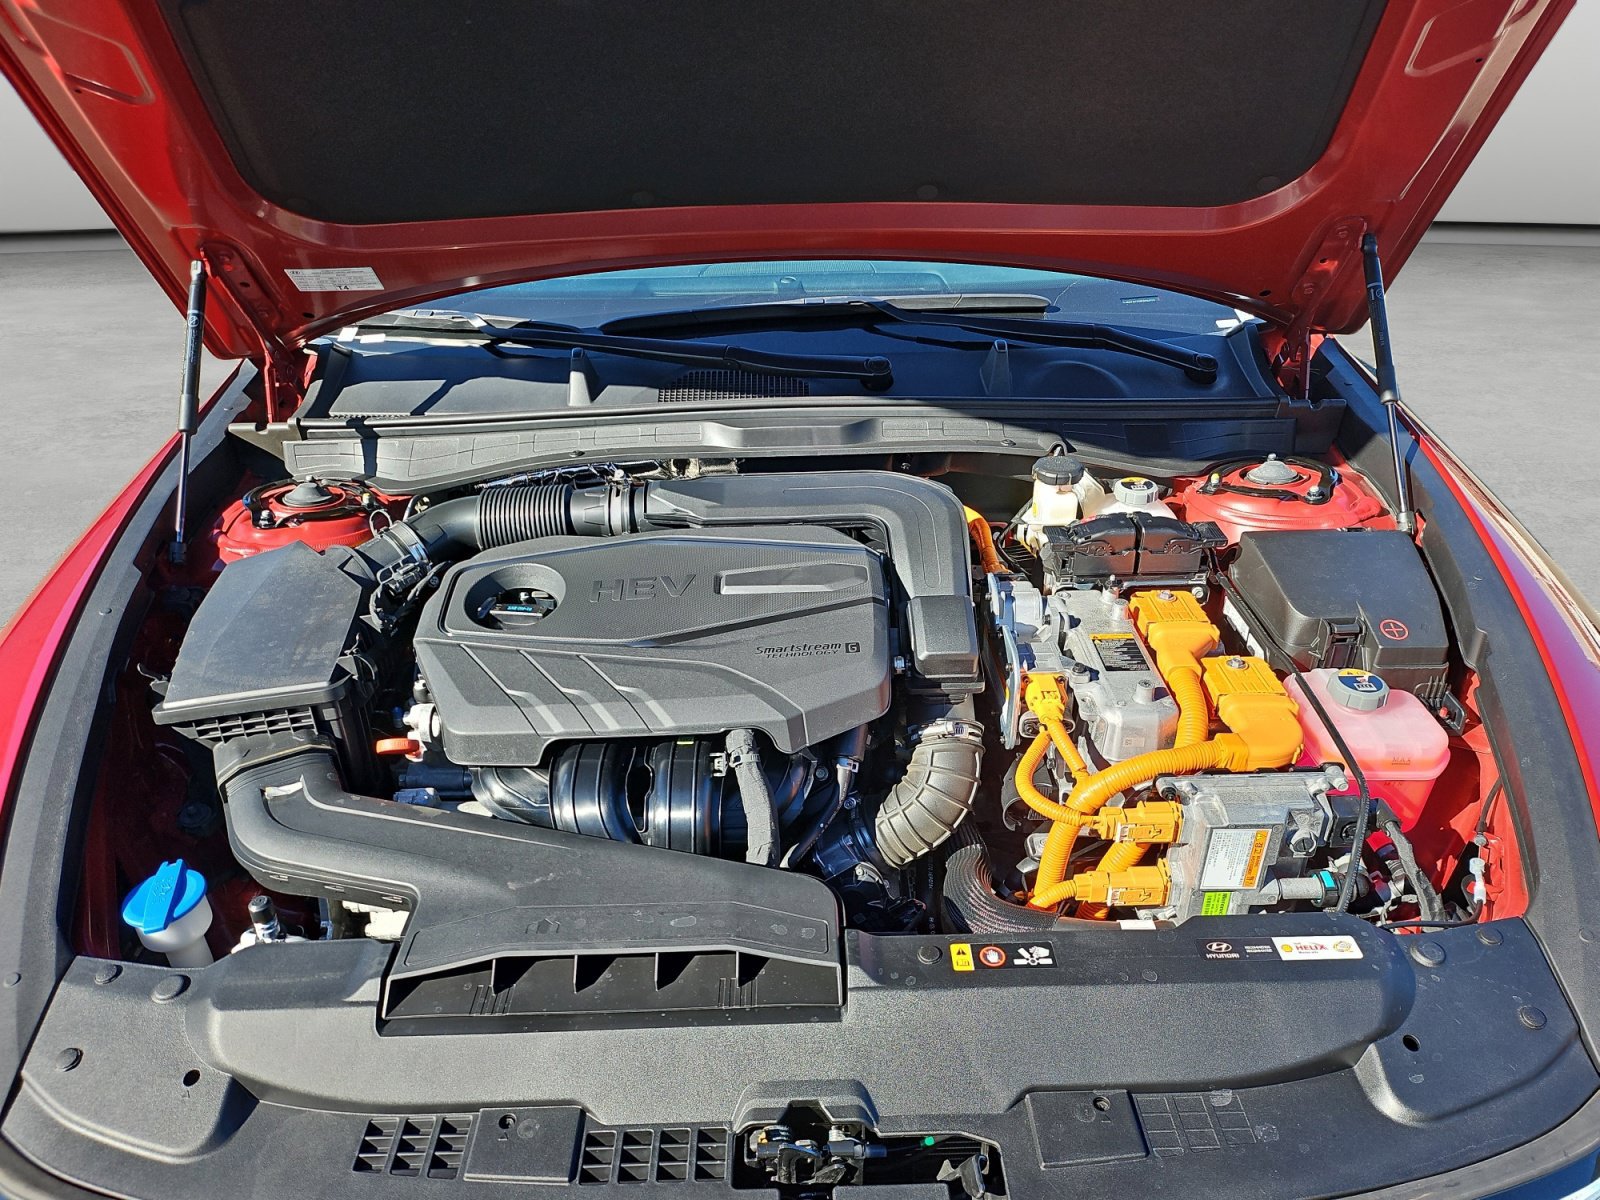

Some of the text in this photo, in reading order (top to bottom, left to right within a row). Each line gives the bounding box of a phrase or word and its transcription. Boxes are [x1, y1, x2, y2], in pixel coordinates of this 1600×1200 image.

[590, 574, 697, 603] HEV
[755, 643, 842, 655] Smartstream
[766, 650, 839, 659] TECHNOLOGY
